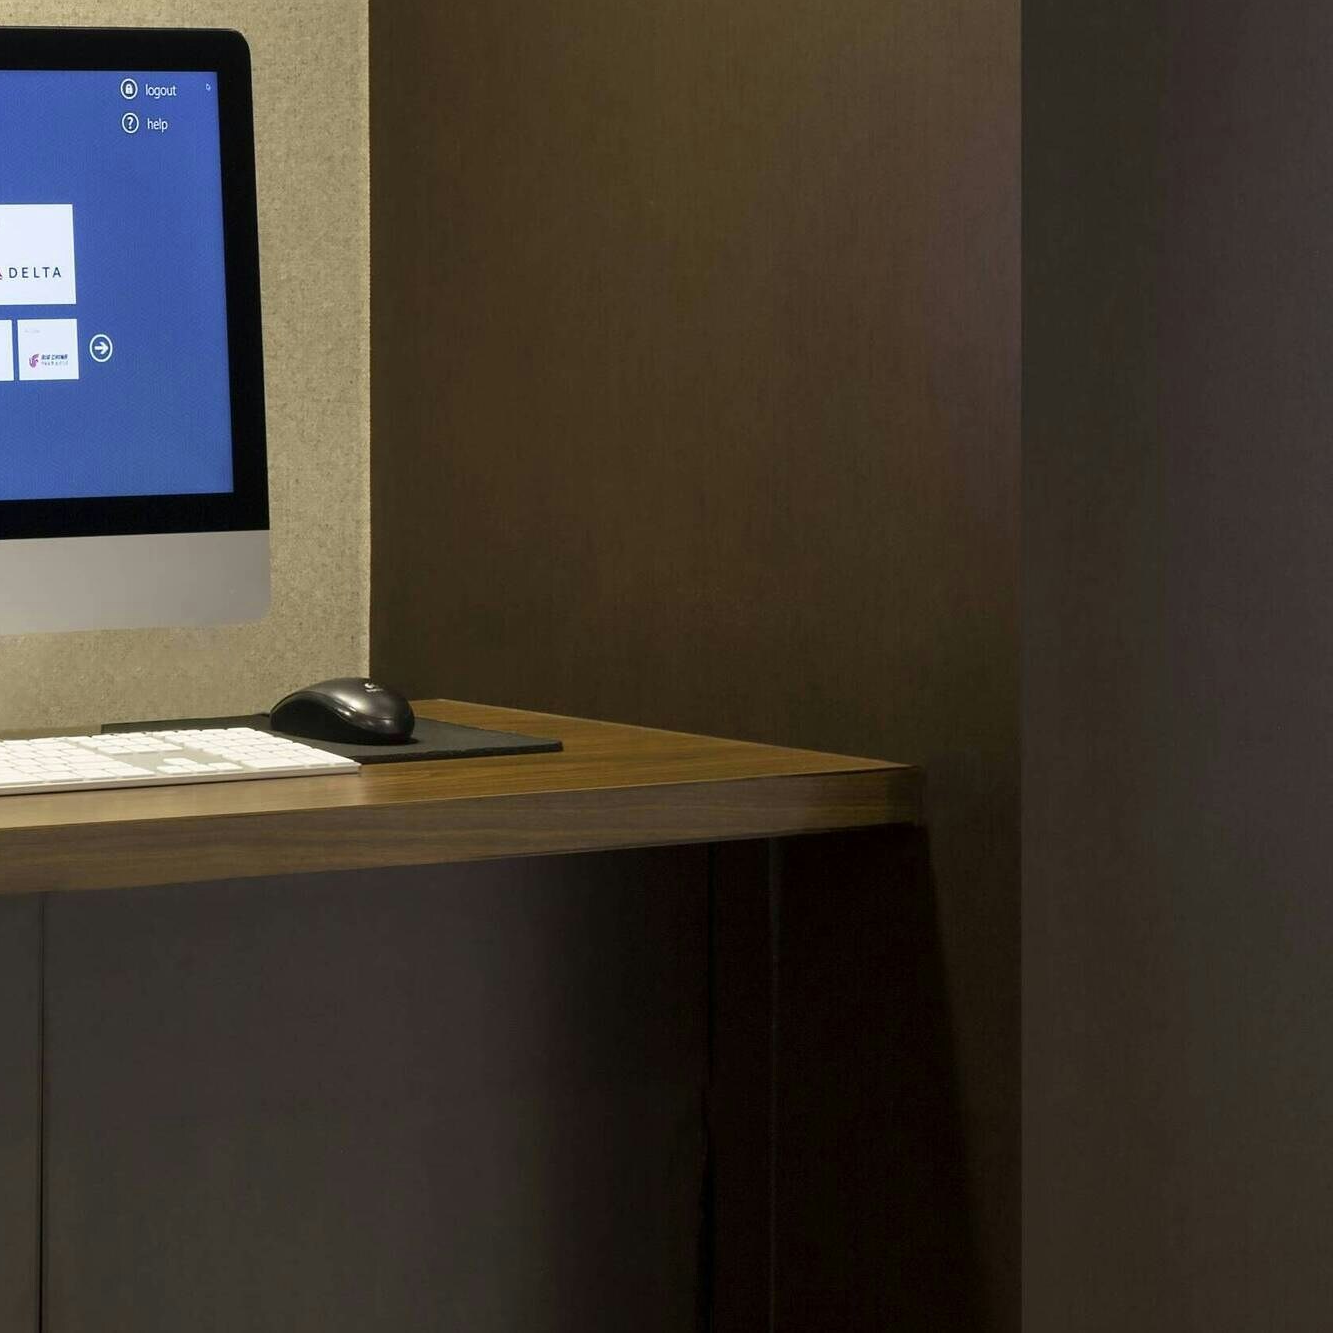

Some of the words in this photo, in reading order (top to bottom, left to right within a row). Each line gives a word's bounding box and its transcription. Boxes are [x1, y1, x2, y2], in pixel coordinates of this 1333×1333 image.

[145, 83, 177, 99] logout
[147, 117, 168, 133] help
[8, 267, 62, 279] DELTA
